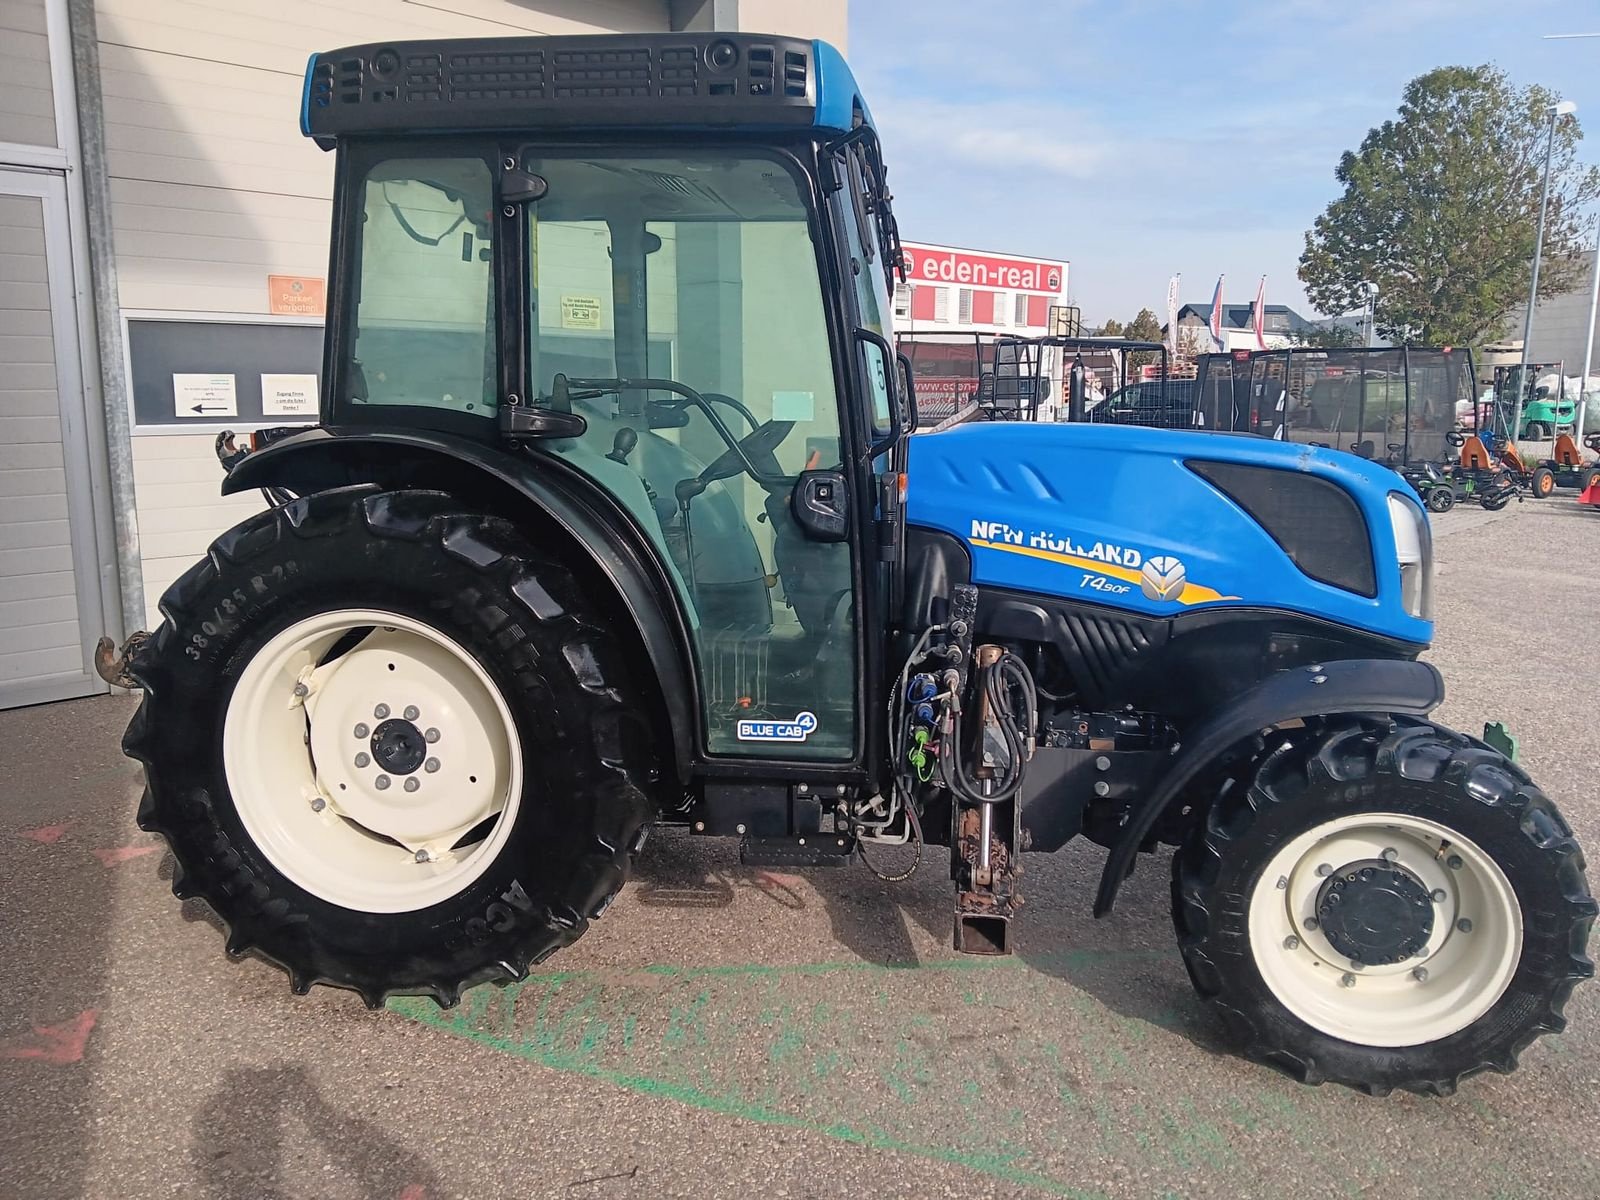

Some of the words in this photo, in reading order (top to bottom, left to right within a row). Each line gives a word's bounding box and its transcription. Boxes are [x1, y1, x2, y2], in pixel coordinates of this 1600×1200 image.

[923, 254, 1041, 289] eden-real
[282, 293, 312, 303] Parken
[741, 724, 774, 736] BLUE
[776, 726, 802, 737] CAB
[799, 716, 813, 728] 4
